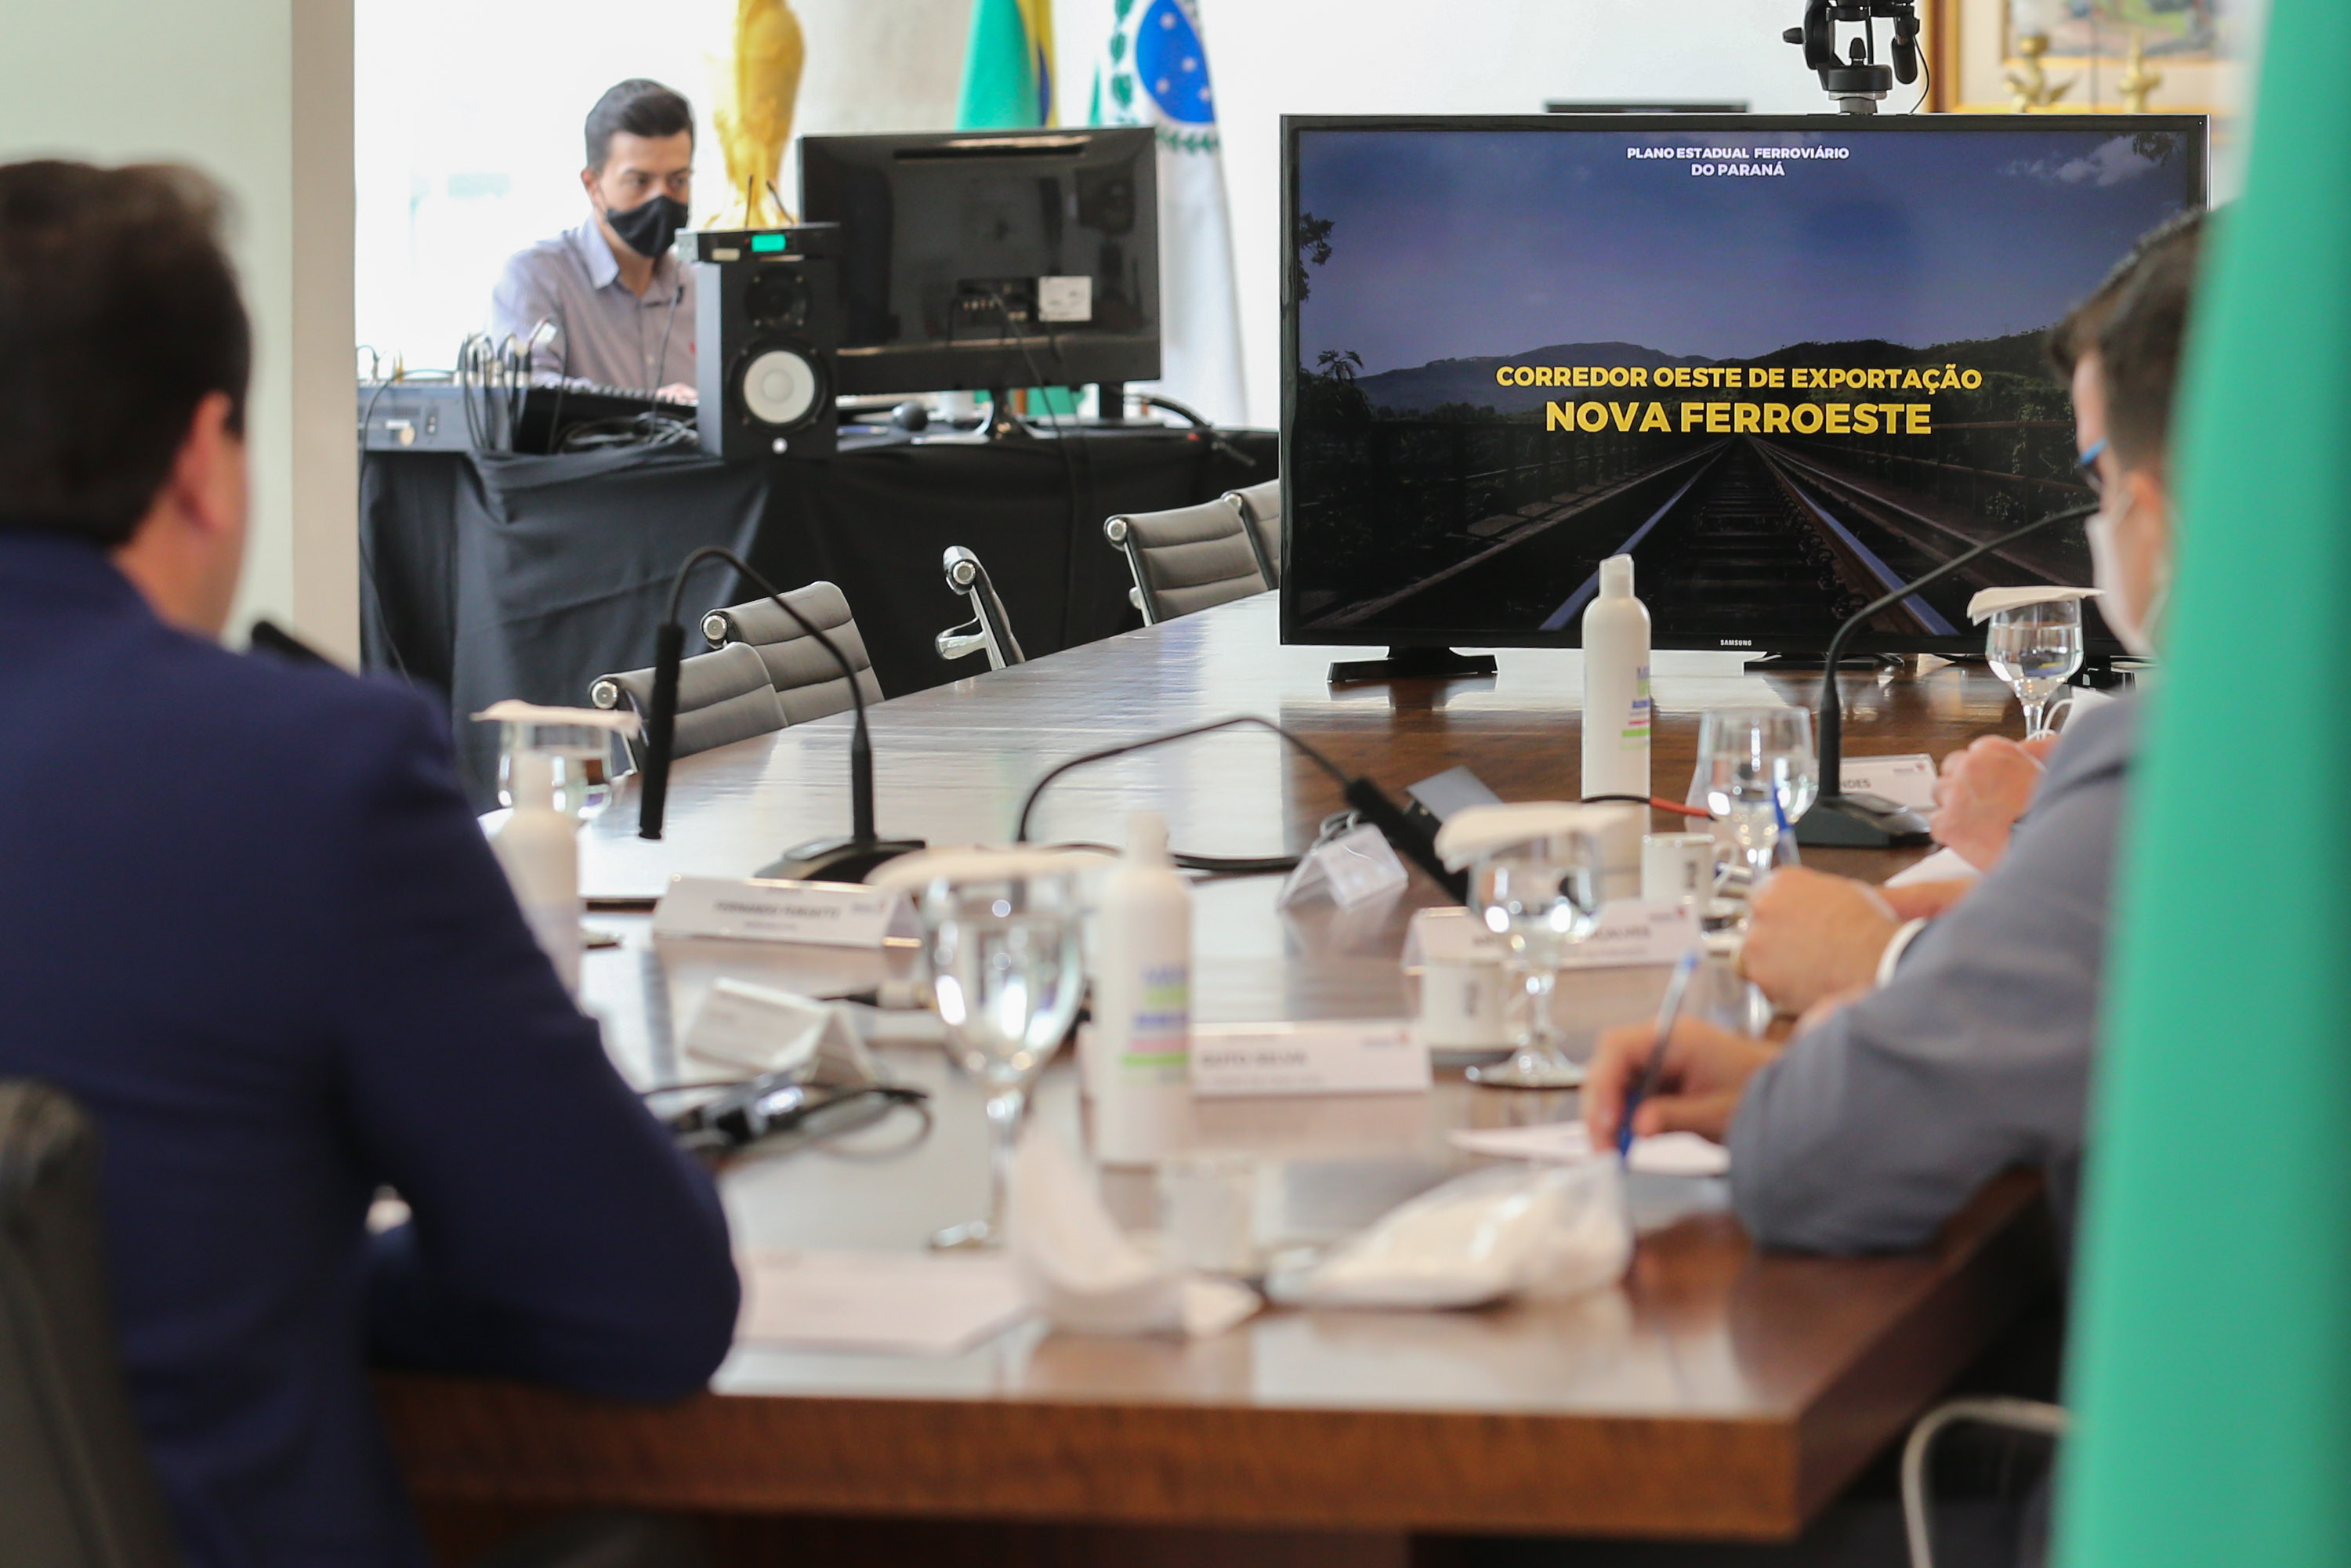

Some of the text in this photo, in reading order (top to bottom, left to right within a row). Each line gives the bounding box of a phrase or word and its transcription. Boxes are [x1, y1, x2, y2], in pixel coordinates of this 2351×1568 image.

[1627, 145, 1849, 159] PLANO ESTADUAL FERROVIÁRIO
[1691, 161, 1785, 176] DO PARANÁ
[1496, 364, 1983, 394] CORREDOR OESTE DE EXPORTAÇÃO
[1546, 401, 1932, 434] NOVA FERROESTE
